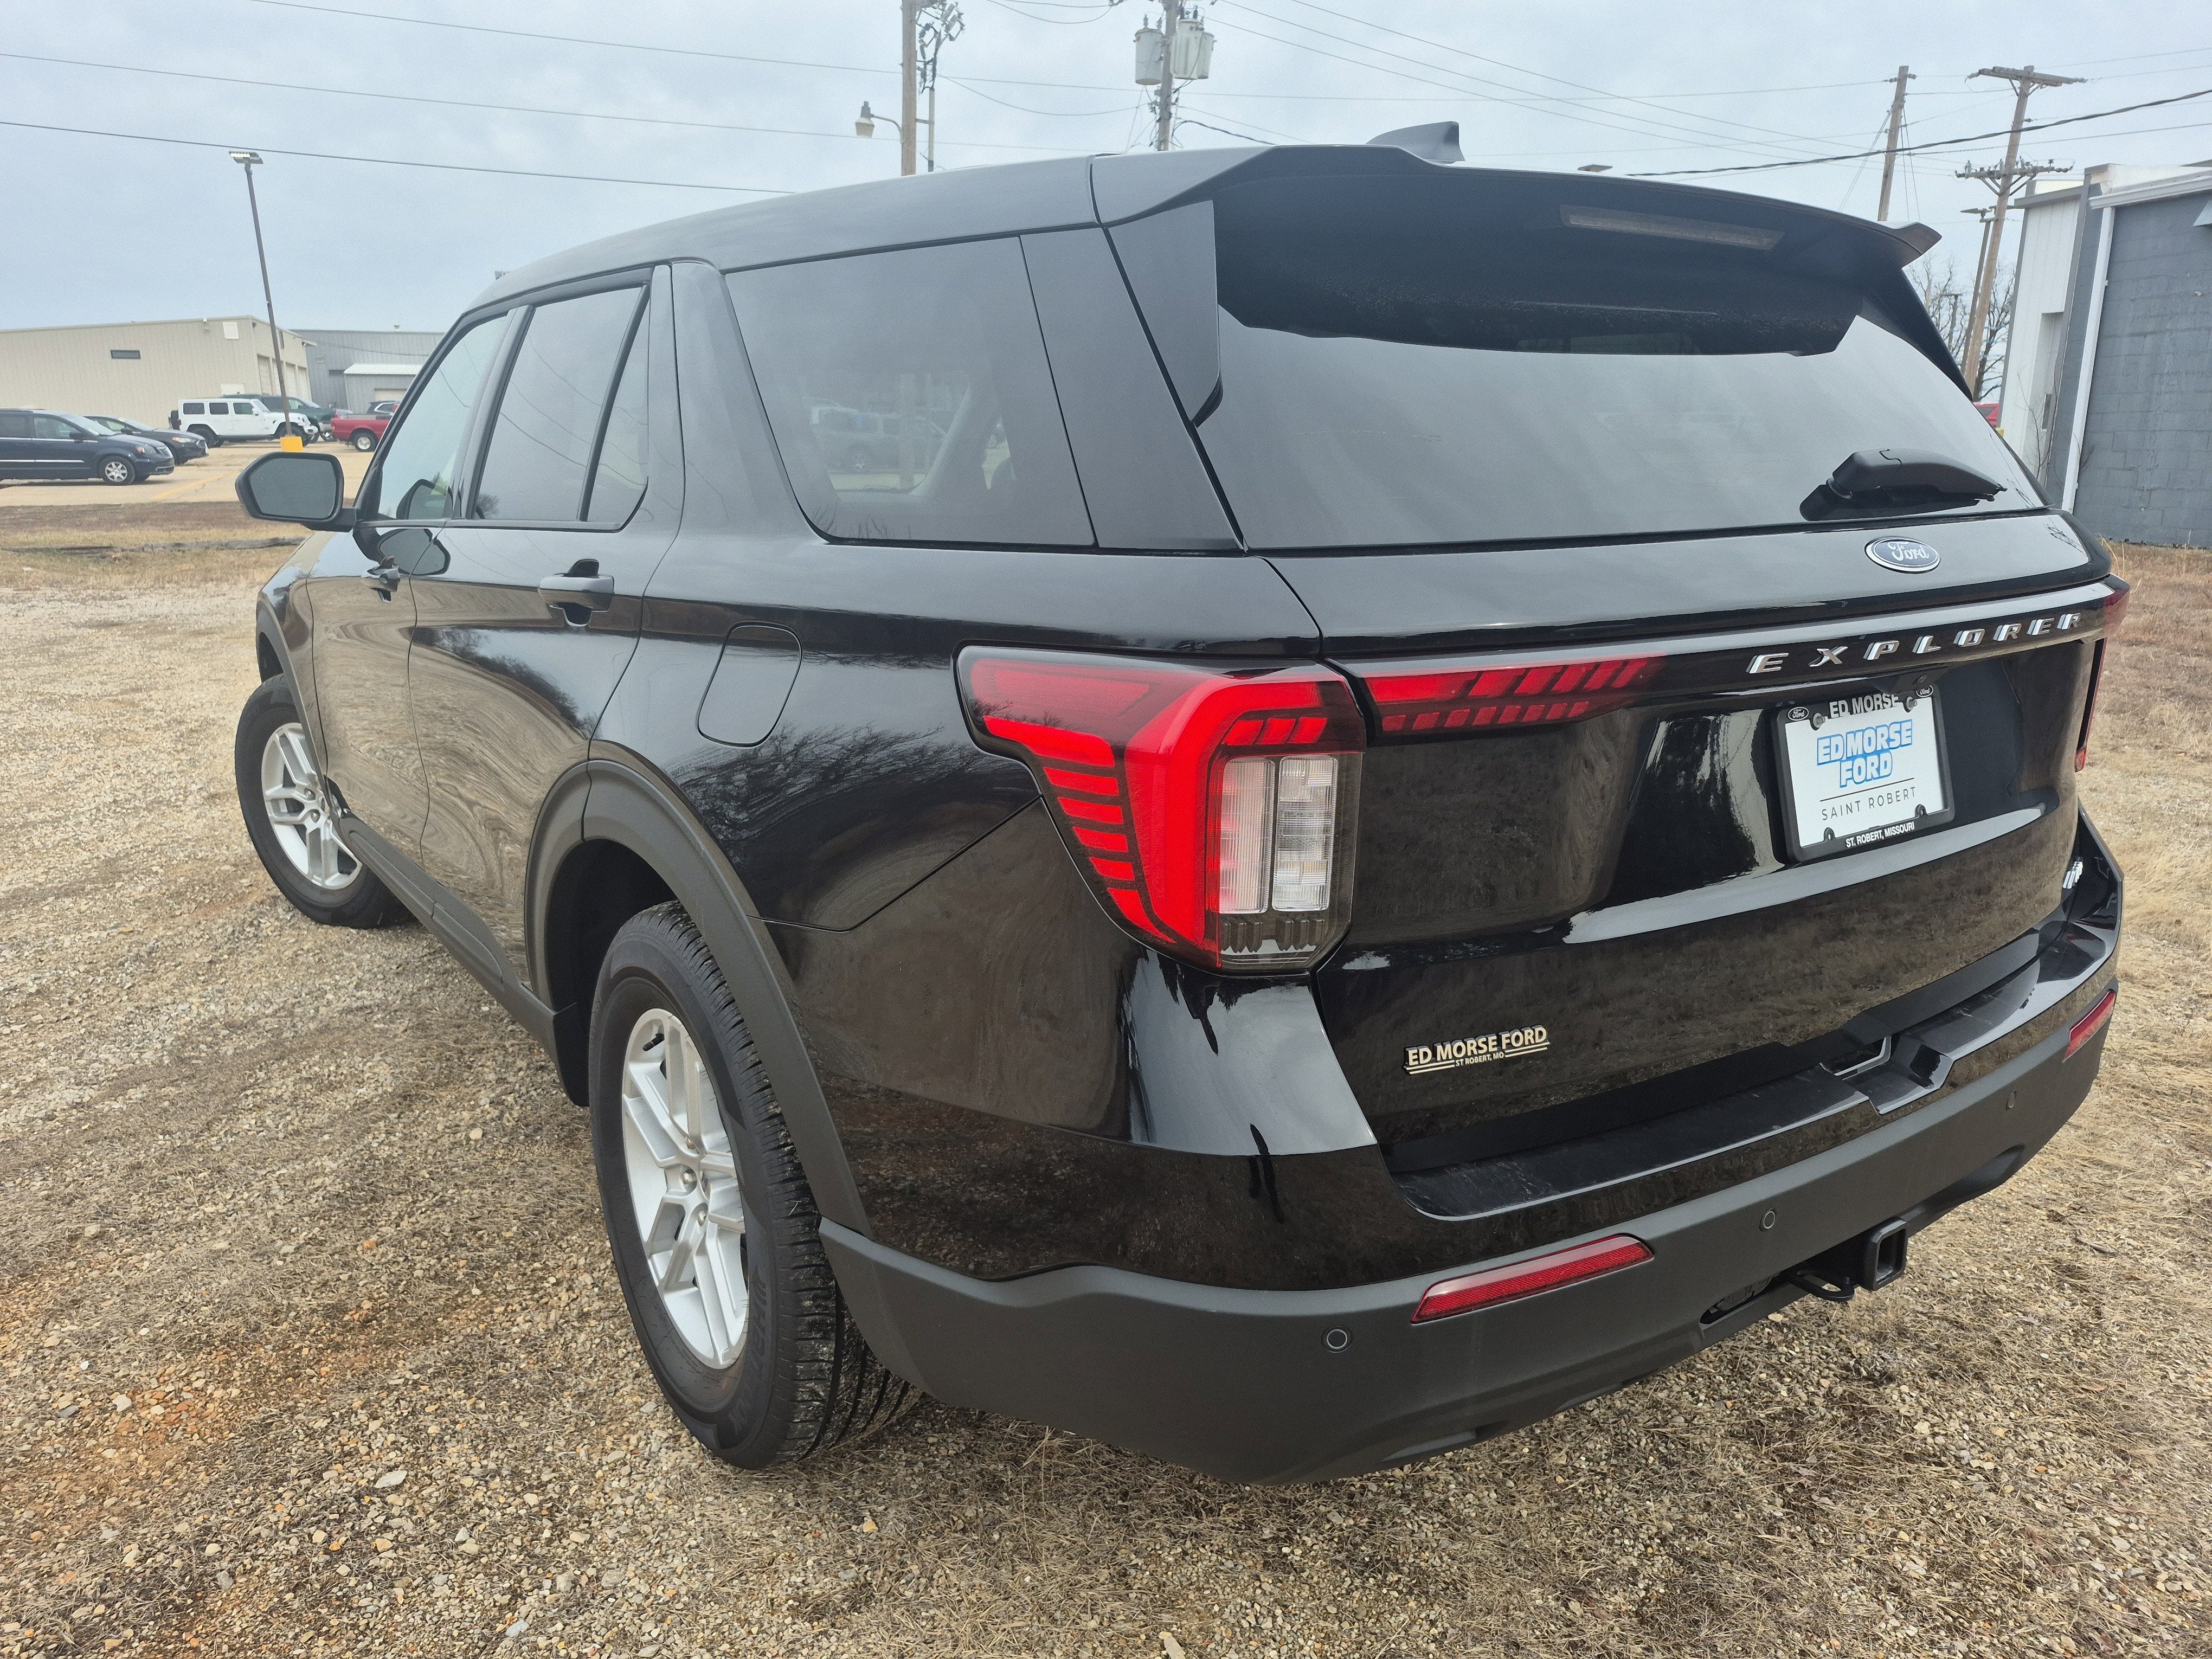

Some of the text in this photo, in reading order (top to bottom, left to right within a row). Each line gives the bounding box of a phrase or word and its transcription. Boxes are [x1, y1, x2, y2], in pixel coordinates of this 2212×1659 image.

[1887, 541, 1930, 561] Ford
[1746, 613, 2081, 674] EXPLORER
[1829, 693, 1899, 718] ED MORSE
[1817, 719, 1913, 766] ED MORSE
[1840, 750, 1893, 788] FORD
[1822, 787, 1915, 820] SAINT ROBERT
[1846, 821, 1915, 848] ST. ROBERT, MISSOURI
[1407, 1026, 1547, 1066] ED MORSE FORD
[1465, 1054, 1492, 1065] ROBERT,
[1493, 1051, 1504, 1060] MO
